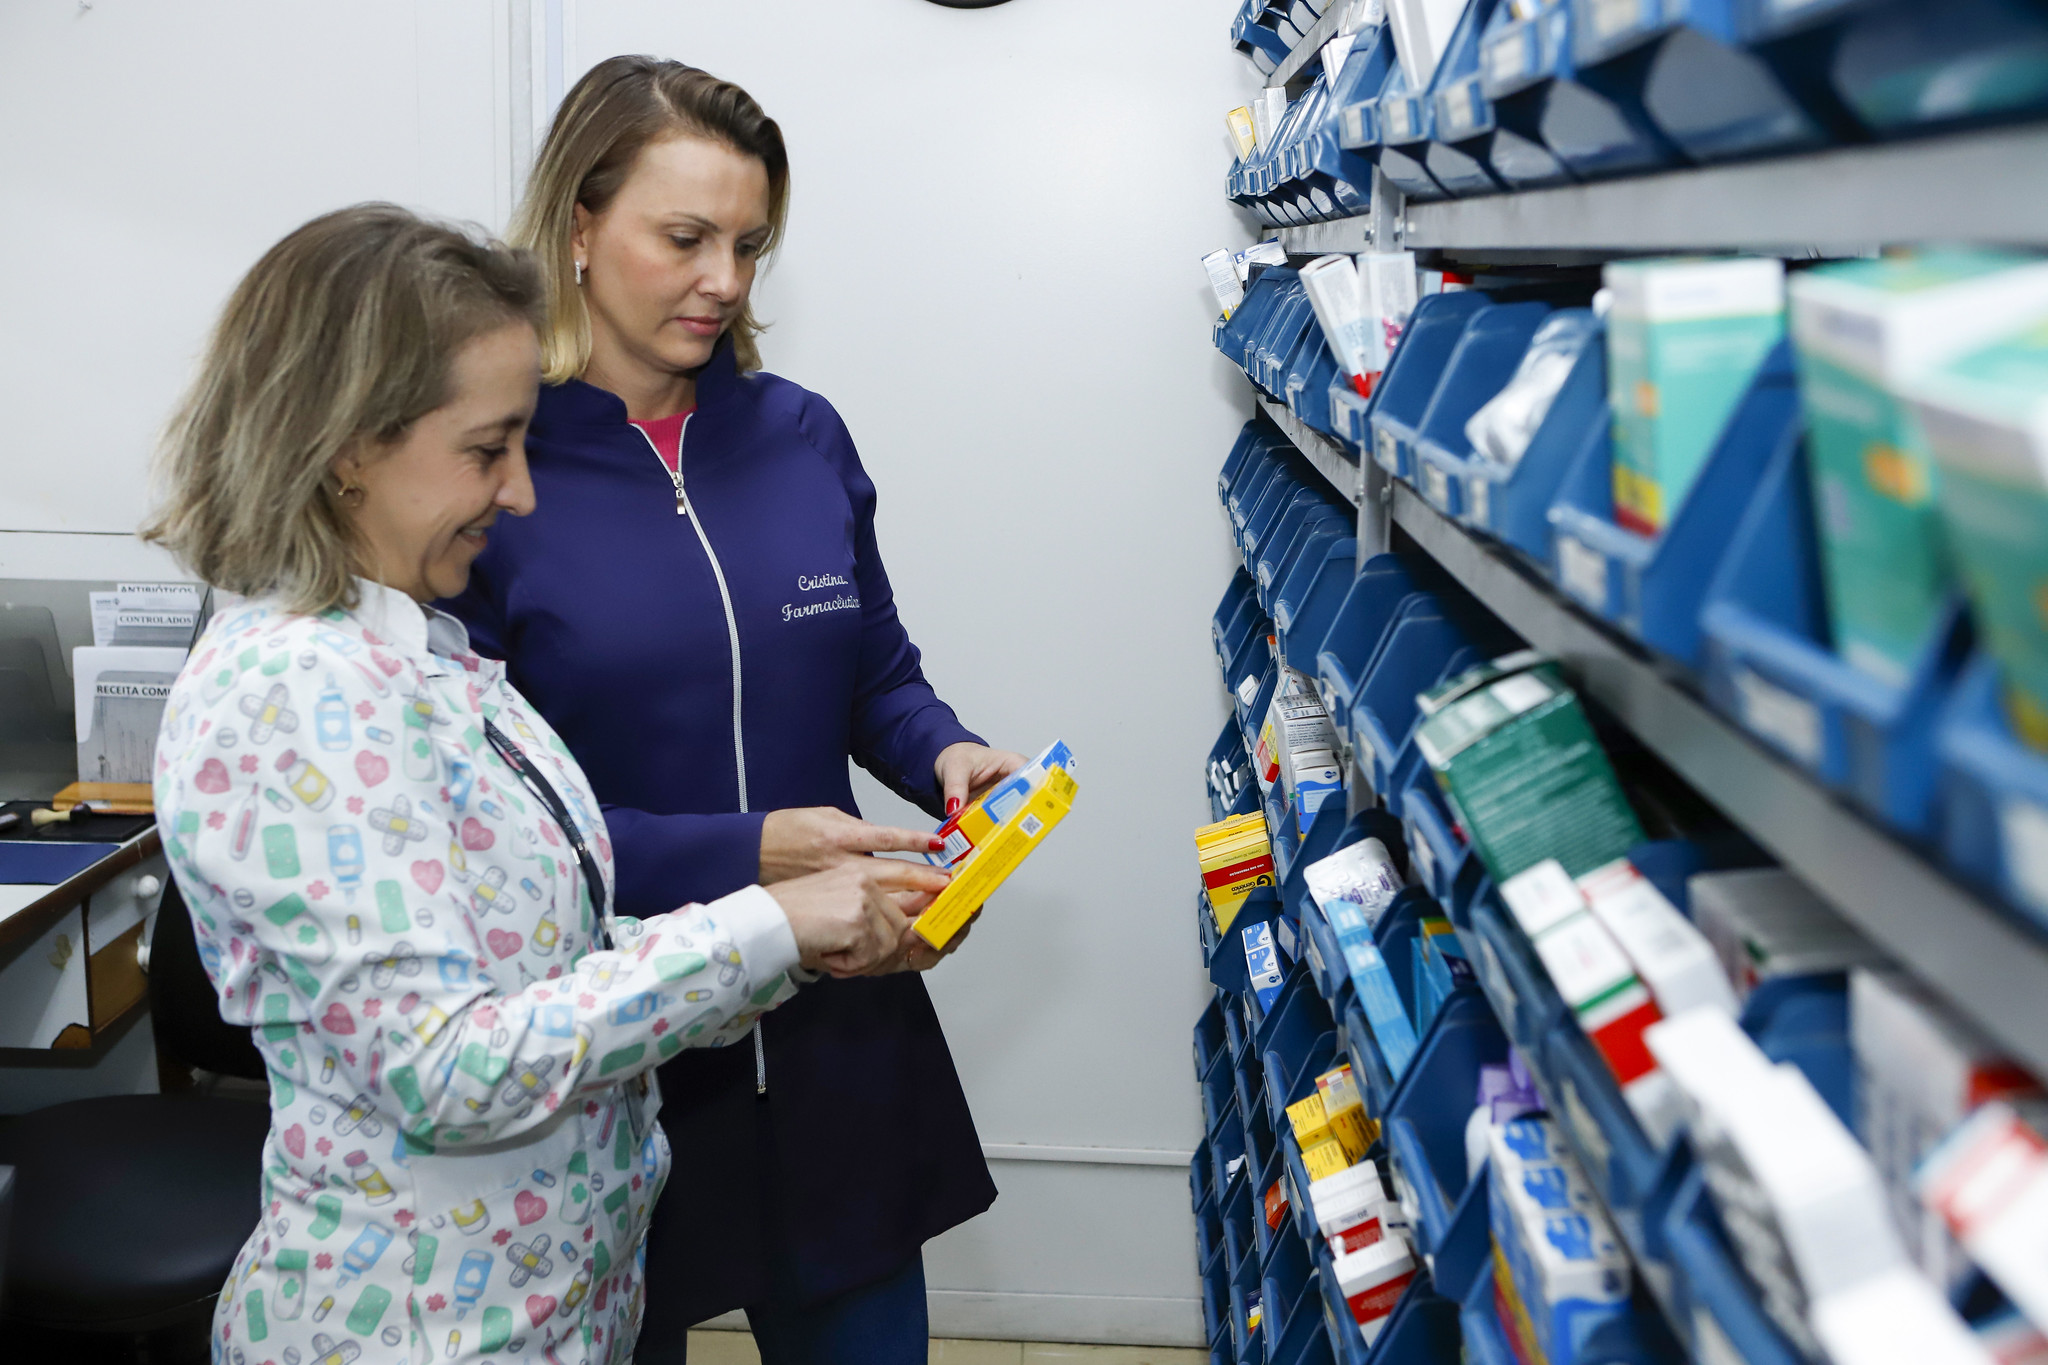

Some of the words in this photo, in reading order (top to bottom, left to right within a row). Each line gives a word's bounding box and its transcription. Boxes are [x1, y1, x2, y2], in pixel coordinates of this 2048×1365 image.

[798, 573, 849, 591] Cristina
[119, 615, 192, 625] CONTROLADOS
[96, 684, 139, 696] RECEITA
[1231, 881, 1256, 892] Genérico
